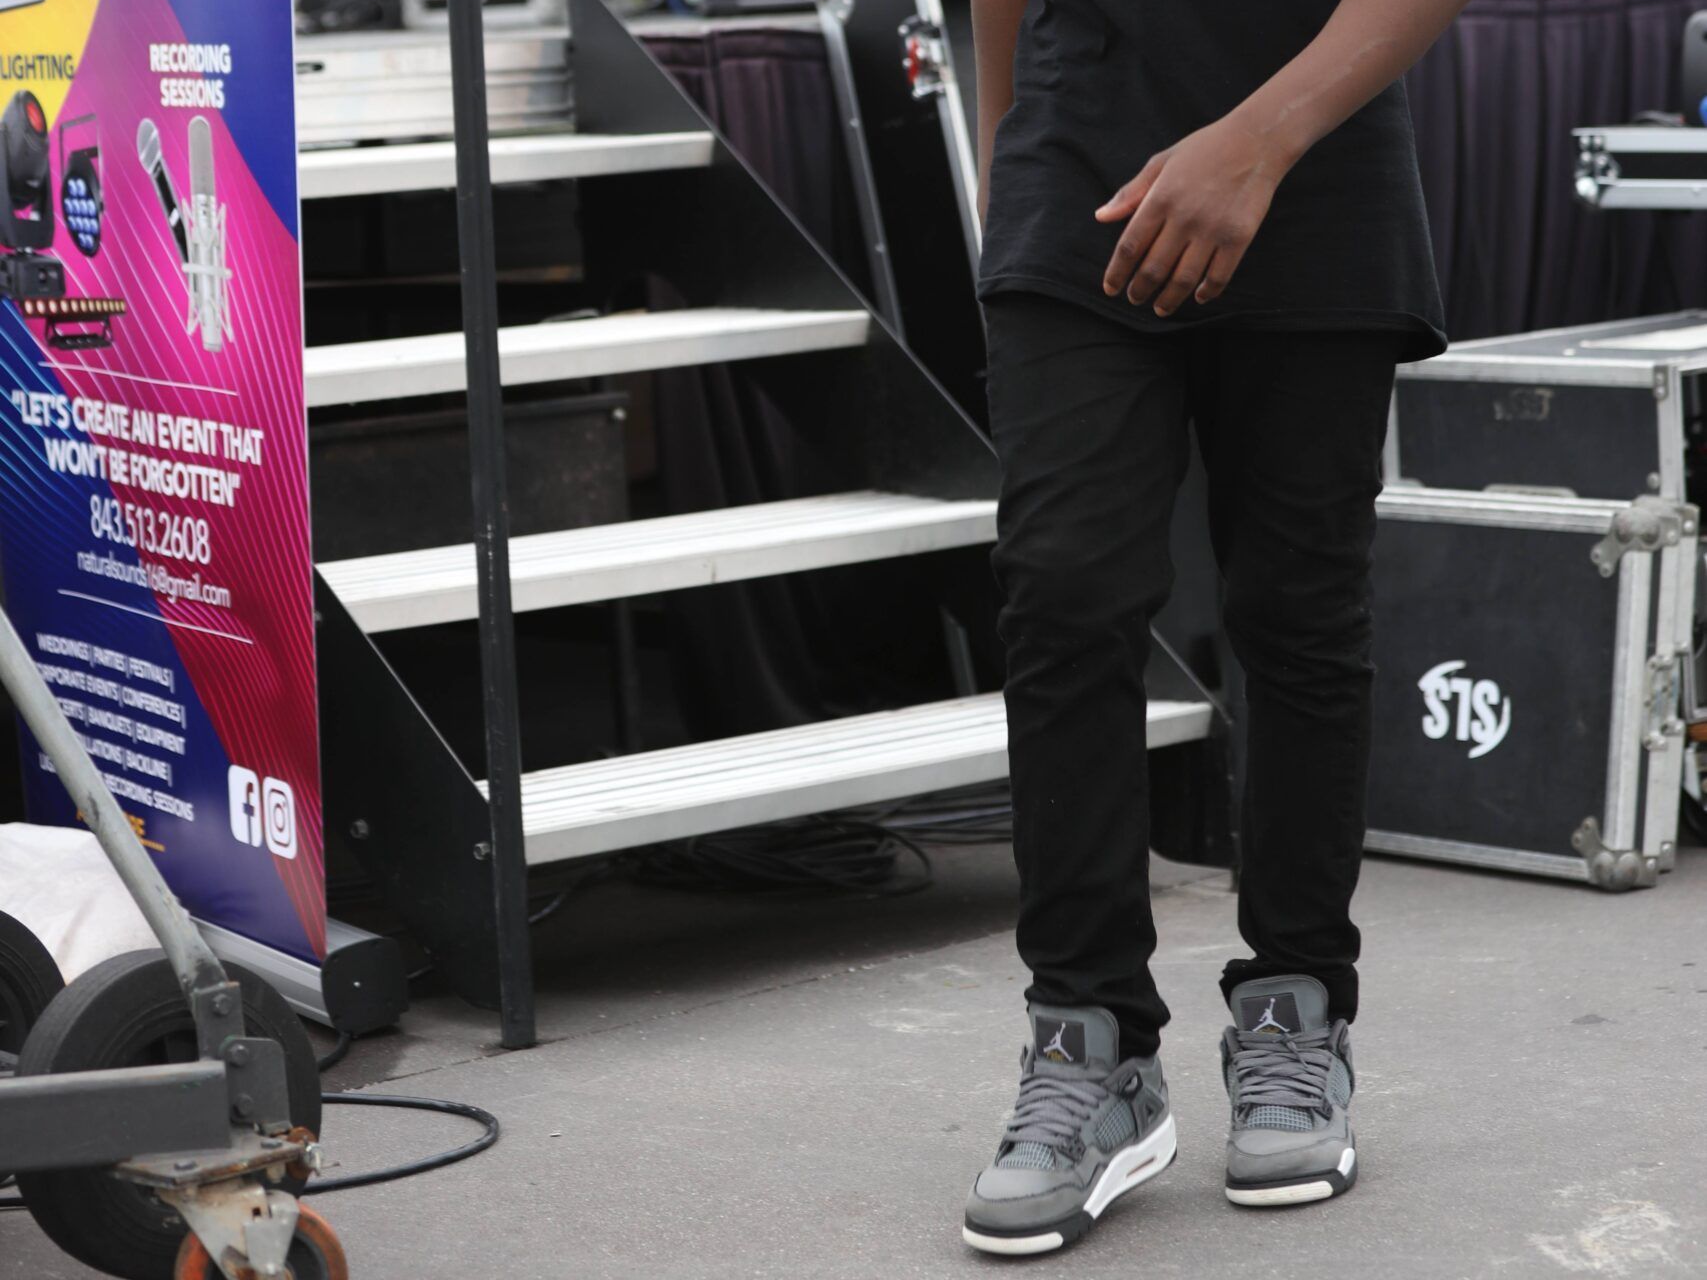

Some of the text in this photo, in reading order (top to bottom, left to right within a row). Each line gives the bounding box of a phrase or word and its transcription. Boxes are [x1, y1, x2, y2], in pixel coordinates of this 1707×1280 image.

[0, 54, 76, 80] LIGHTING
[149, 43, 232, 74] RECORDING
[160, 77, 225, 109] SESSIONS
[72, 395, 130, 441] CREATE
[131, 408, 156, 447] AN
[157, 413, 219, 457] EVENT
[219, 422, 264, 466] THAT
[44, 436, 107, 481] WON'T
[108, 448, 129, 485] BE
[90, 494, 212, 565] 843.513.2608
